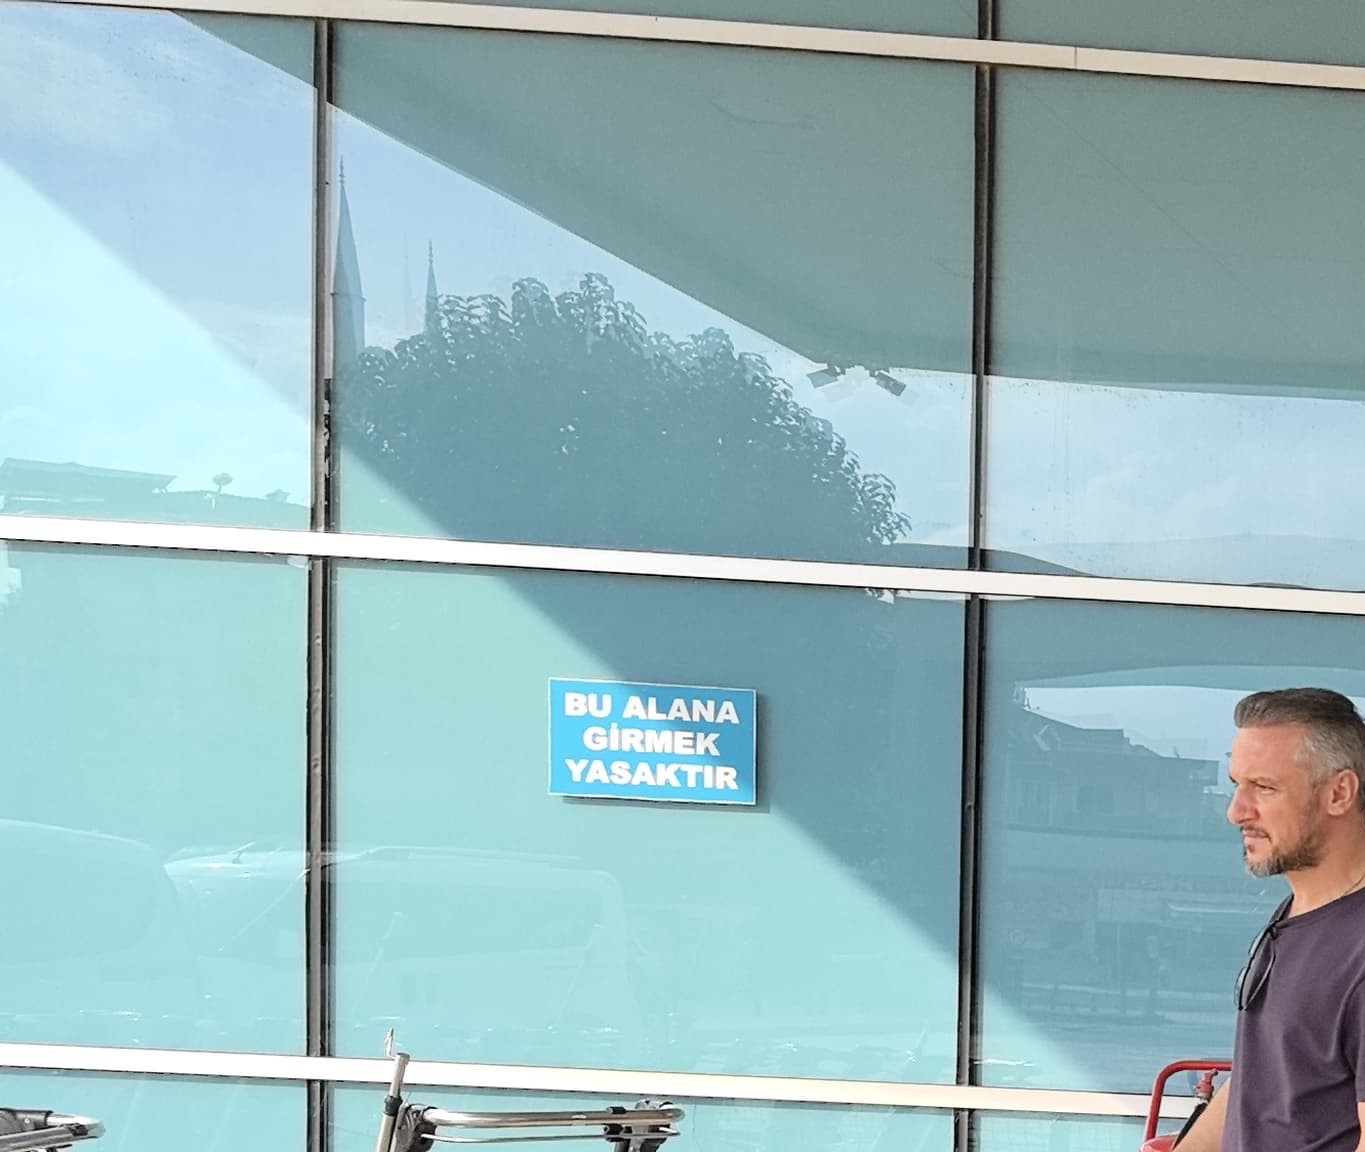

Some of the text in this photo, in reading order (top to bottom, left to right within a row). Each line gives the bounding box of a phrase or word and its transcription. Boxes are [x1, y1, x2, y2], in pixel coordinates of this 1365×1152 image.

[564, 692, 740, 724] BU ALANA
[582, 722, 720, 756] GİRMEK
[564, 759, 738, 790] YASAKTIR
